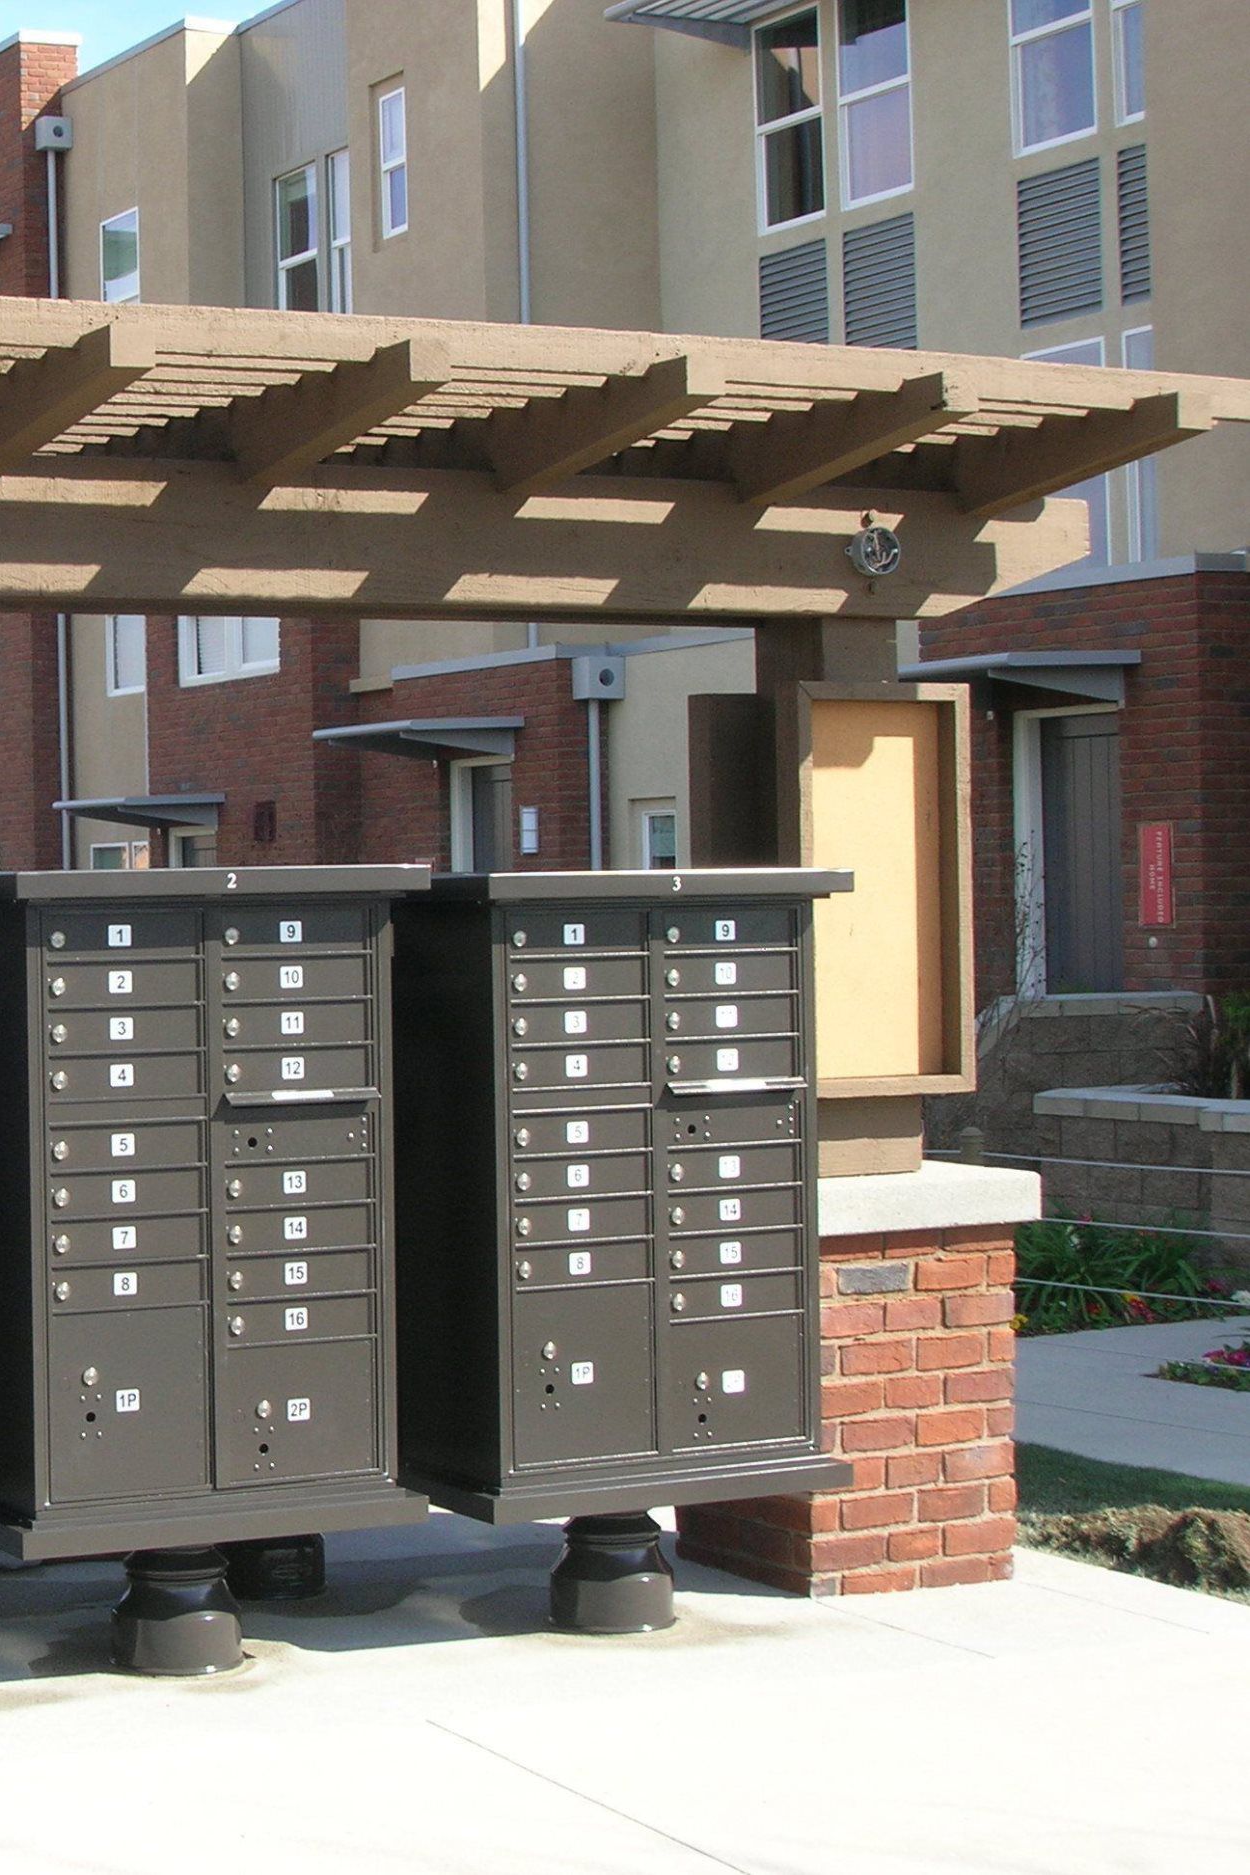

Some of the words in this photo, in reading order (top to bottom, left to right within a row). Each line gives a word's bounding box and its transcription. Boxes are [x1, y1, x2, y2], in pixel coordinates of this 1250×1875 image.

[227, 872, 237, 888] 2
[672, 876, 681, 891] 3
[116, 929, 123, 943] 1
[286, 925, 296, 939] 9
[571, 927, 578, 942] 1
[721, 923, 730, 938] 9
[117, 975, 126, 990] 2
[285, 970, 300, 984] 10
[117, 1022, 127, 1036] 3
[286, 1016, 300, 1029] 11
[286, 1061, 301, 1075] 12
[573, 1060, 581, 1072] 4
[117, 1069, 127, 1082] 4
[574, 1125, 582, 1139] 5
[119, 1138, 129, 1153] 5
[287, 1175, 303, 1189] 13
[574, 1168, 582, 1182] 6
[119, 1184, 128, 1199] 6
[724, 1204, 737, 1216] 14
[288, 1222, 303, 1235] 14
[120, 1231, 129, 1245] 7
[725, 1246, 738, 1259] 15
[576, 1256, 584, 1270] 8
[288, 1266, 305, 1280] 15
[121, 1277, 130, 1292] 8
[289, 1312, 305, 1326] 16
[576, 1366, 591, 1379] 1P
[119, 1394, 137, 1408] 1P
[290, 1403, 308, 1417] 2P
